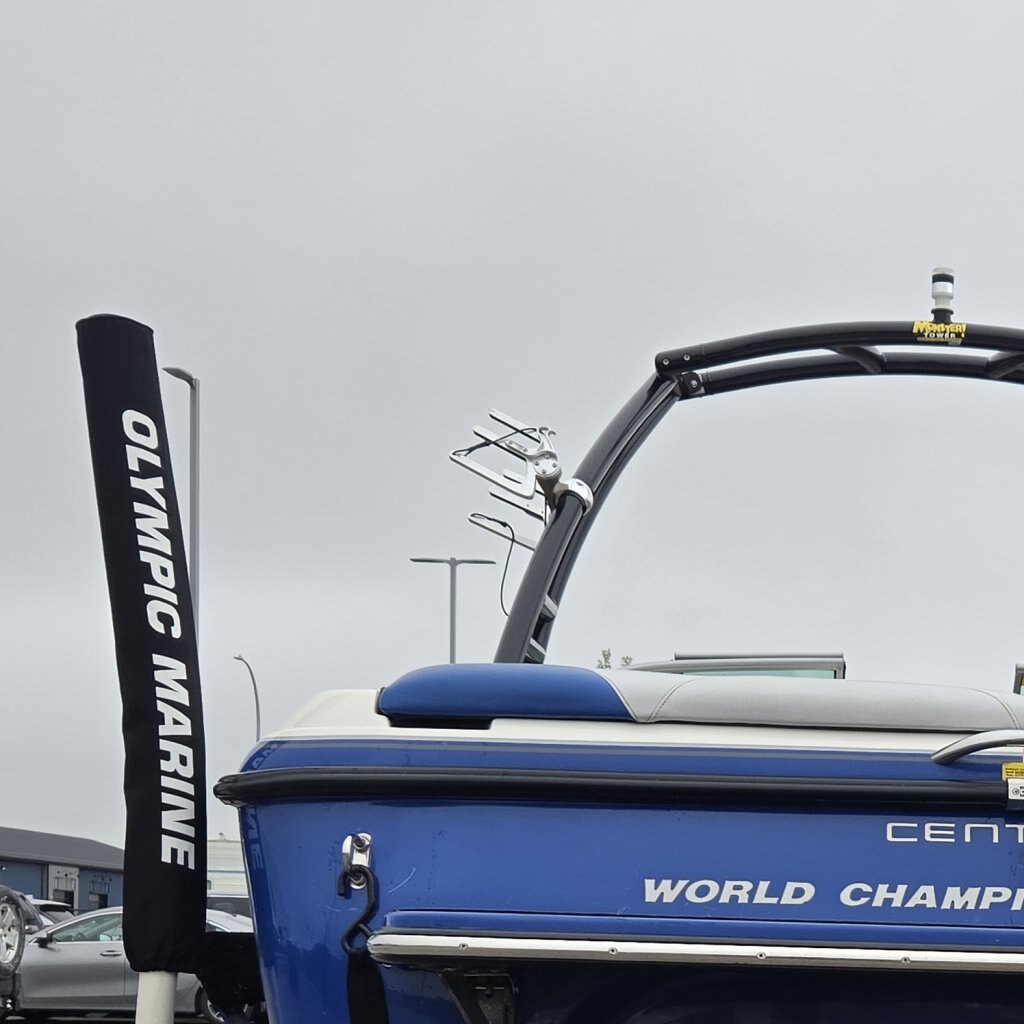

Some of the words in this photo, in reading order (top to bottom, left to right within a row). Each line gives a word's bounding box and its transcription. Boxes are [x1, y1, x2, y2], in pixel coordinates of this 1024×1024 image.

[121, 408, 182, 640] OLYMPIC
[151, 653, 196, 871] MARINE
[643, 879, 816, 905] WORLD
